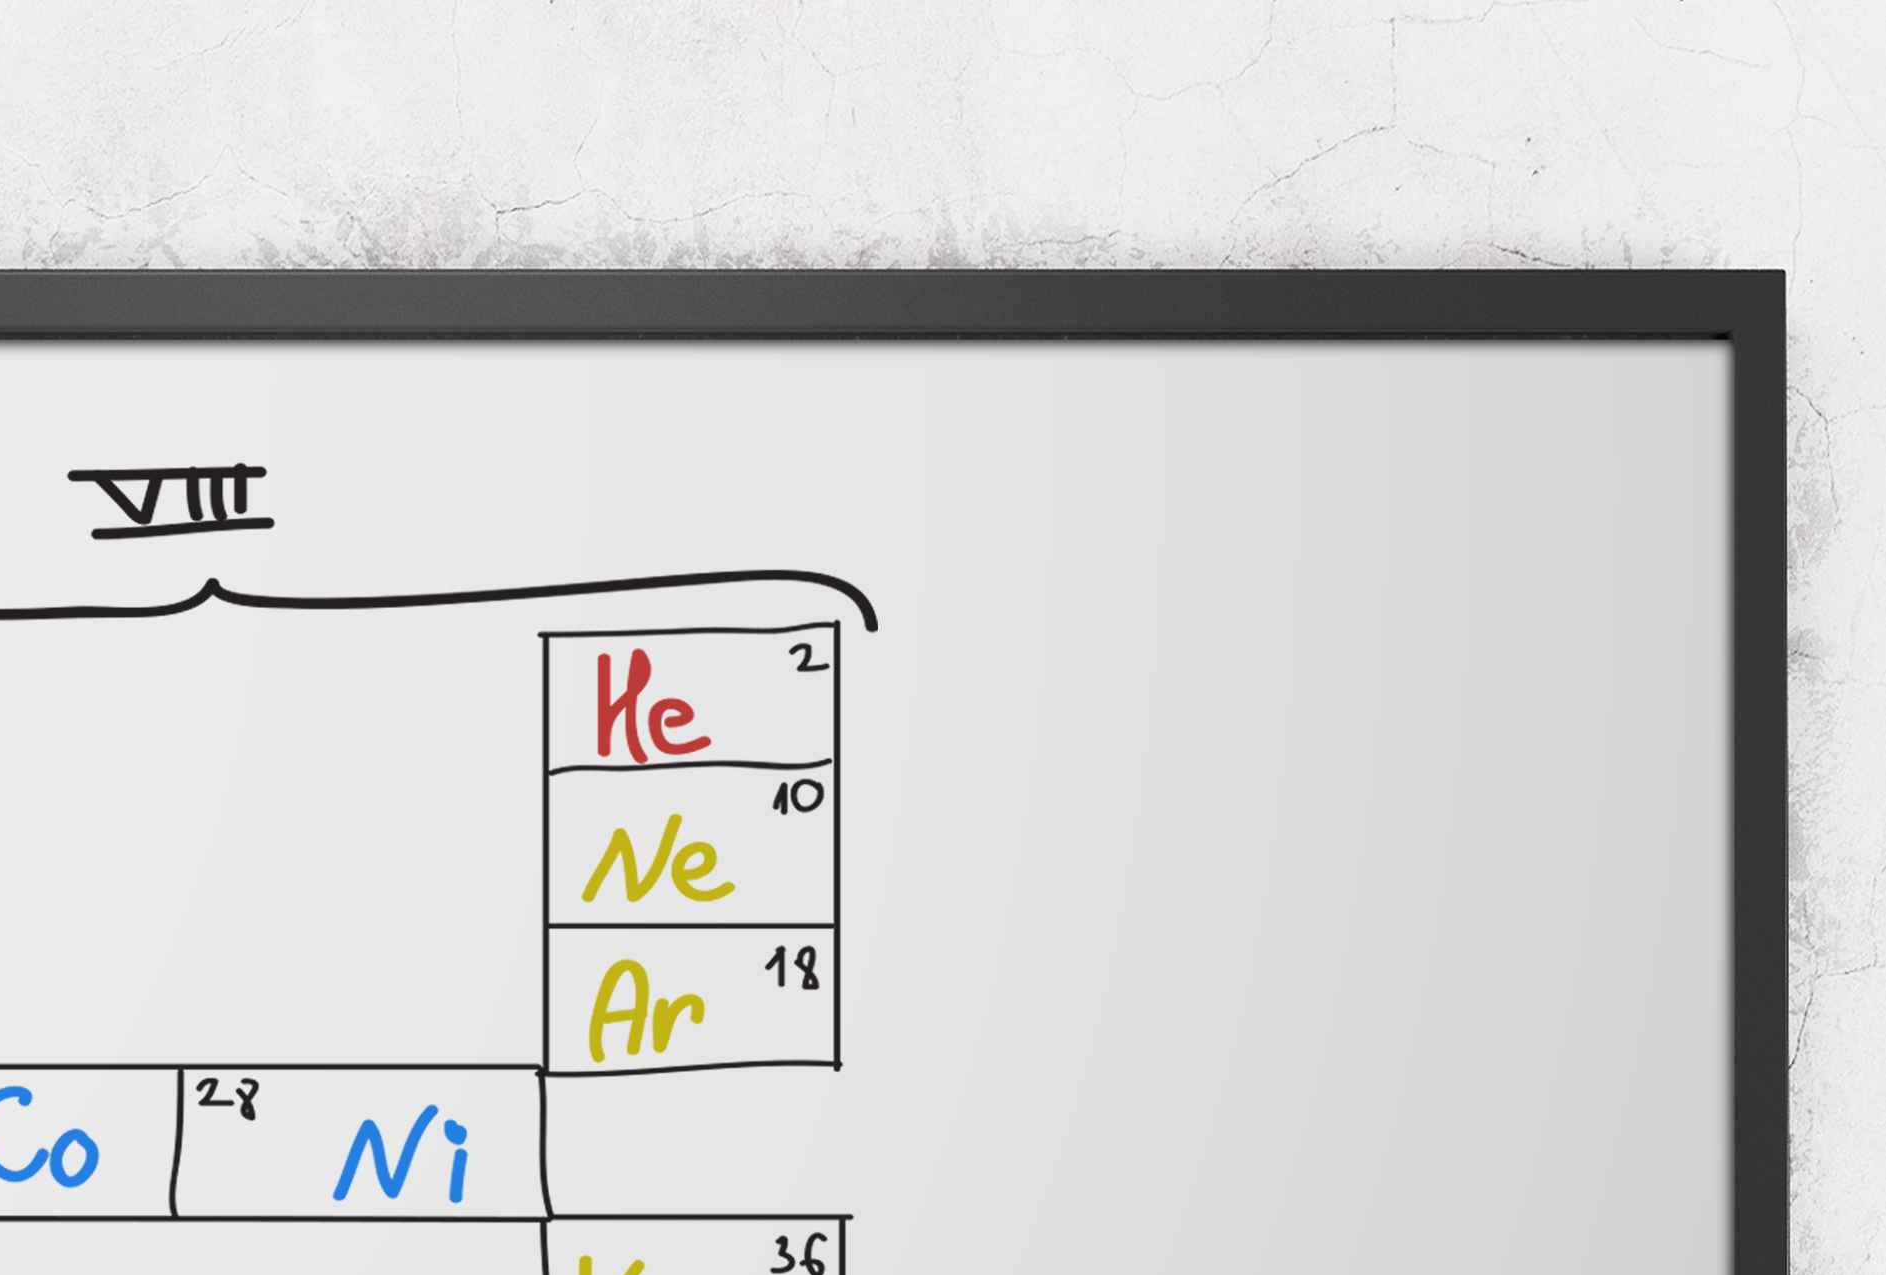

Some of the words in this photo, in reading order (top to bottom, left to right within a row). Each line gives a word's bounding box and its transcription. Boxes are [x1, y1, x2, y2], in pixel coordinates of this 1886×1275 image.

[67, 462, 275, 540] VIII
[597, 648, 711, 764] He
[788, 643, 830, 673] 2
[581, 813, 736, 903] Ne
[772, 778, 825, 815] 10
[588, 959, 706, 1064] Ar
[764, 945, 820, 990] 18
[196, 1077, 259, 1121] 28
[332, 1104, 469, 1204] Ni
